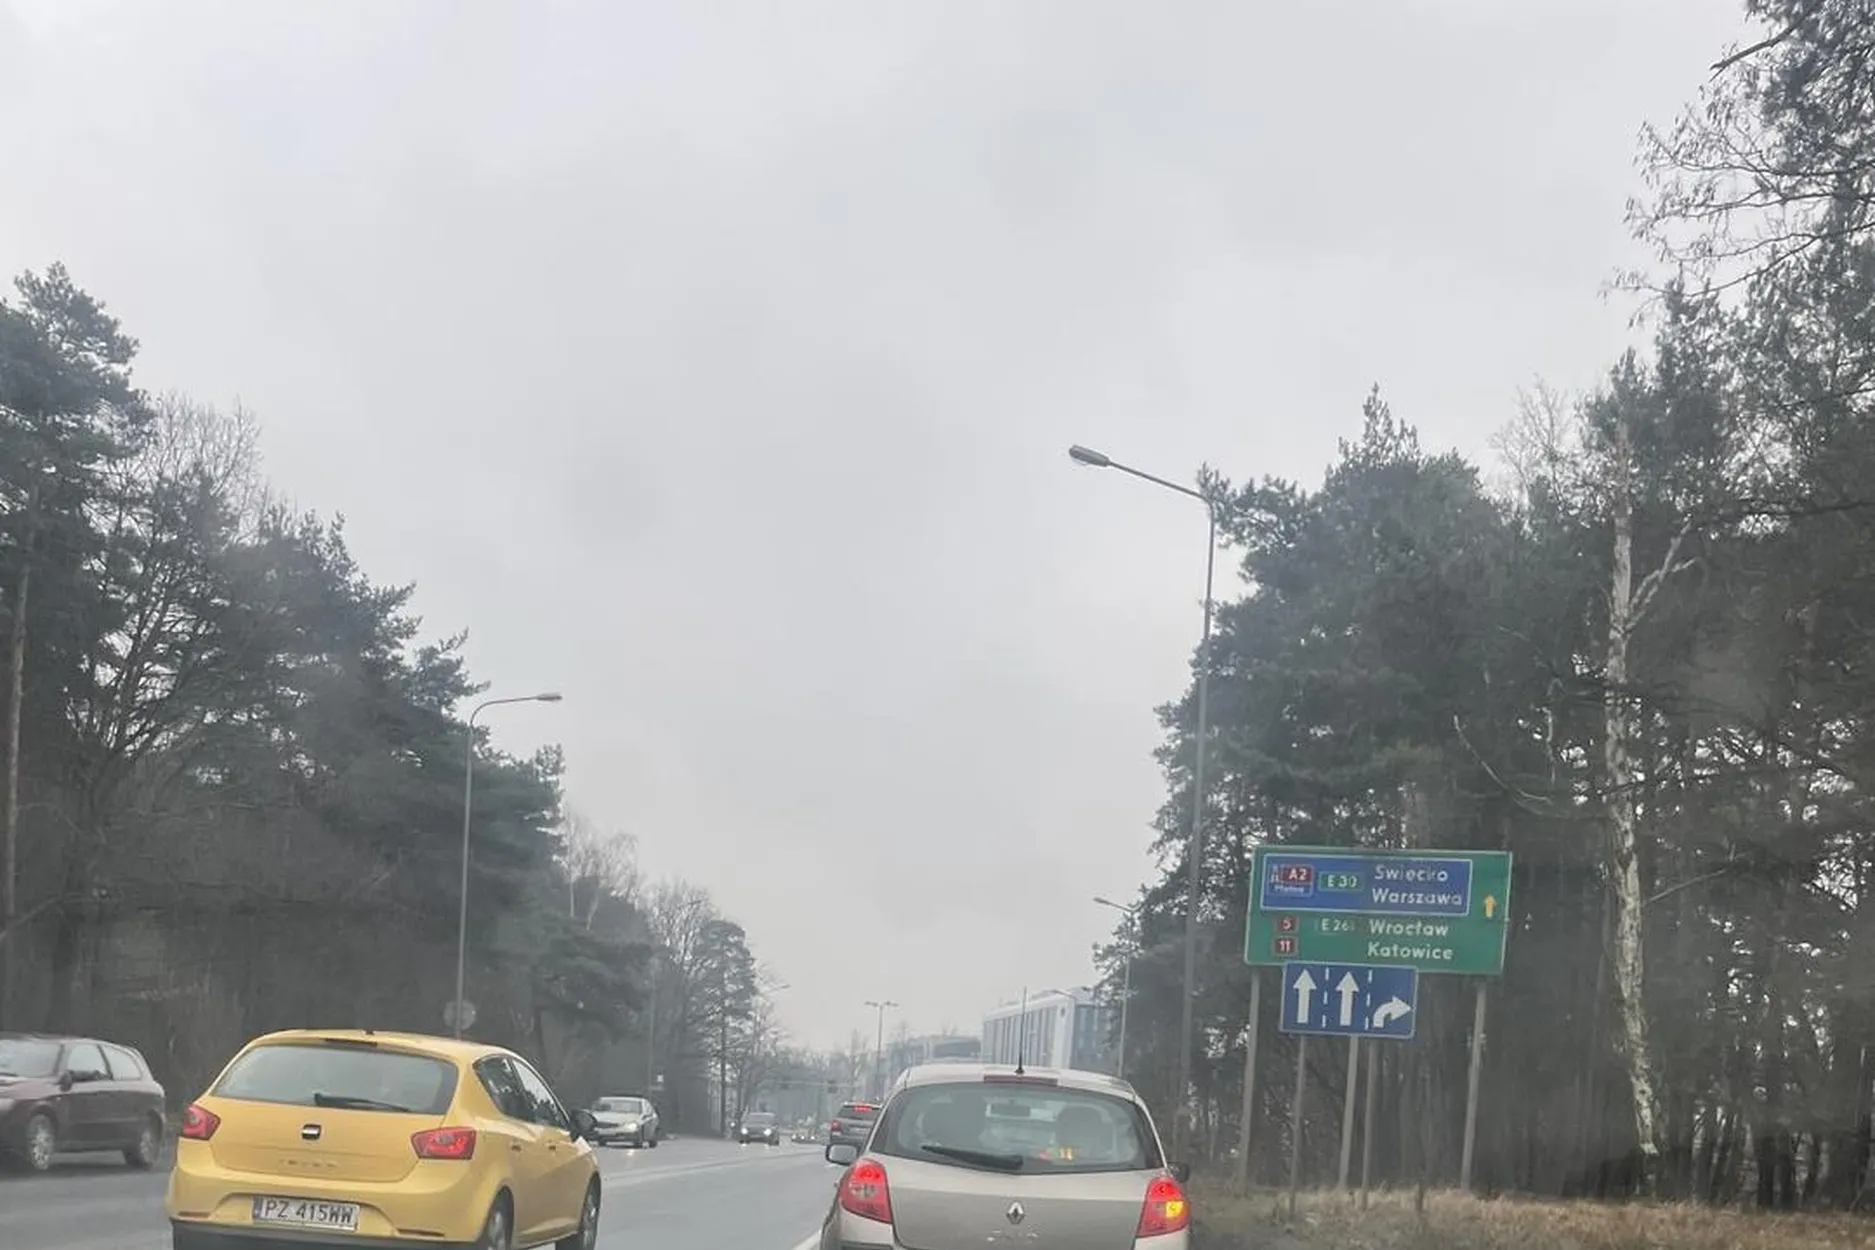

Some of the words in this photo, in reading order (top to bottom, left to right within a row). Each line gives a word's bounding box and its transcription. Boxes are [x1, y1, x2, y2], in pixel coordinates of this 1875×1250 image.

[1372, 887, 1462, 905] Warszawa
[1367, 941, 1454, 960] Katowice
[265, 1200, 290, 1218] PZ
[296, 1202, 354, 1224] 415WW
